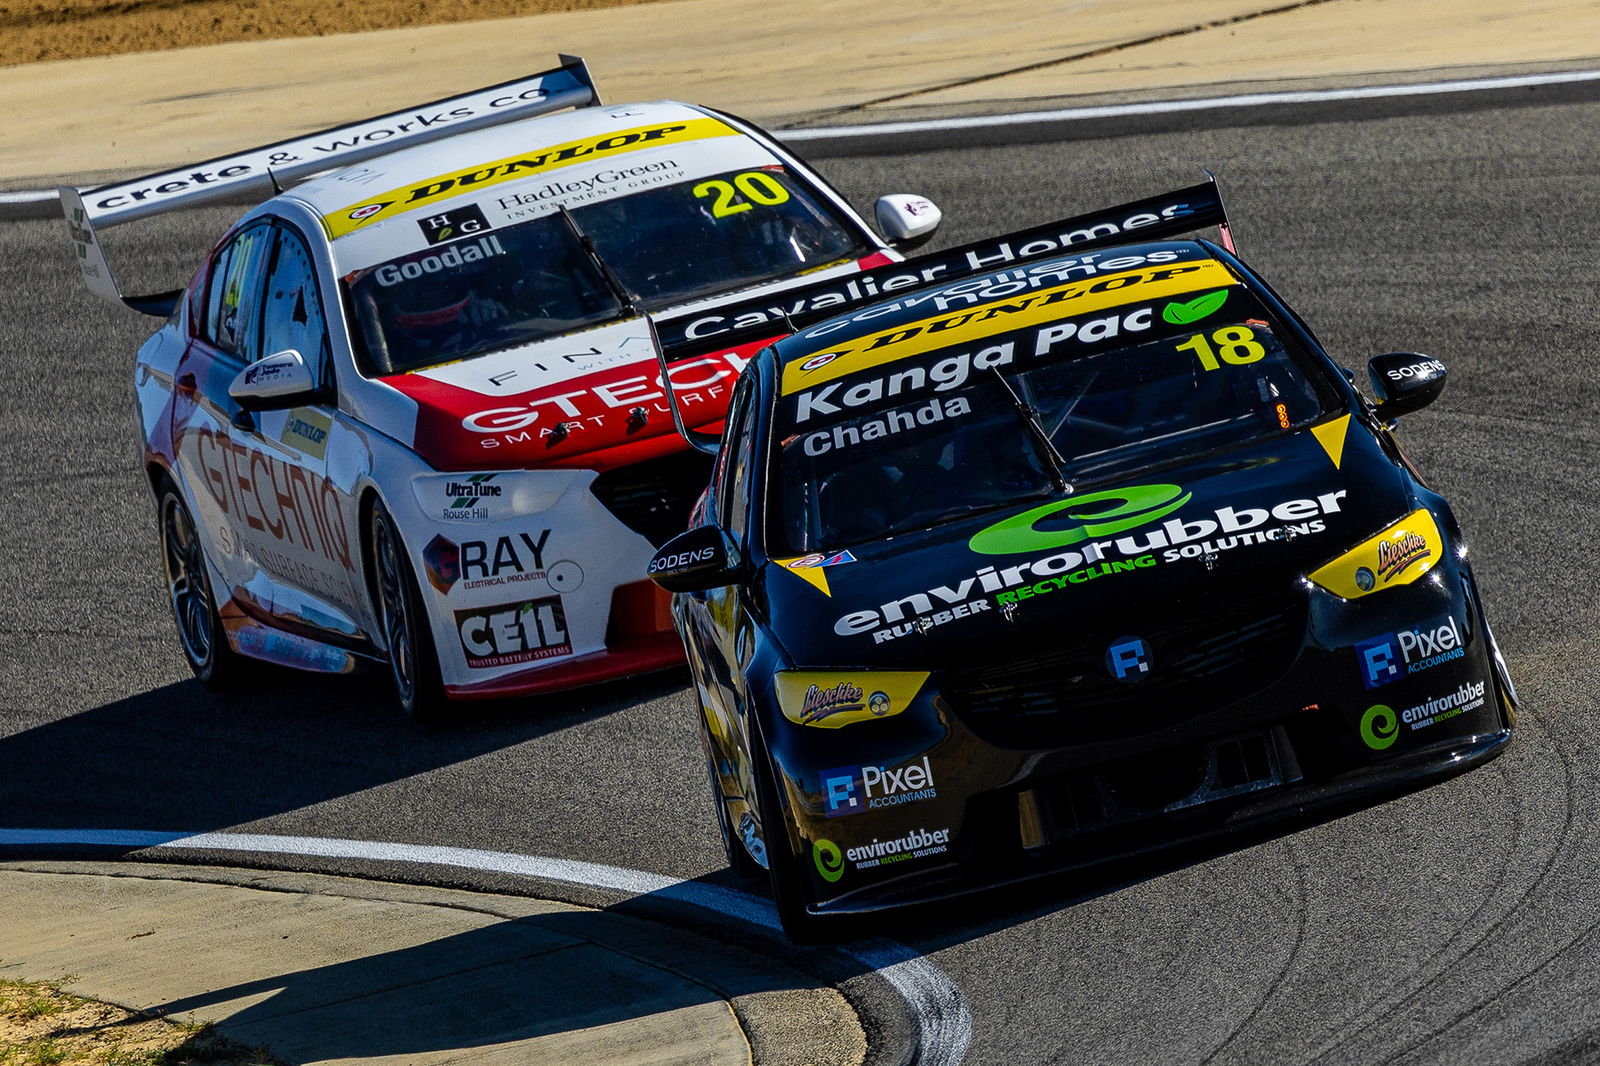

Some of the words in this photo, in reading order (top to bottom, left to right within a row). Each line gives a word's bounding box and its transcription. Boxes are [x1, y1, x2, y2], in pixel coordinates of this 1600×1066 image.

[96, 165, 251, 208] crete
[269, 152, 302, 166] &
[313, 107, 474, 153] works
[404, 125, 686, 204] DUNLOP
[498, 158, 680, 210] HadleyGreen
[506, 186, 620, 219] INVESTMENT
[628, 170, 686, 189] GROUP
[692, 172, 790, 218] 20
[375, 234, 504, 288] Goodall
[684, 264, 947, 340] Cavalier
[966, 203, 1195, 270] Homes
[863, 265, 1201, 352] DUNLOP
[796, 340, 1015, 423] Kanga
[1035, 307, 1152, 357] Pac
[1175, 326, 1266, 371] 18
[1387, 359, 1446, 380] SODENS
[292, 419, 327, 444] DUNLOP
[480, 414, 605, 449] SMART
[803, 396, 971, 457] Chahda
[443, 508, 470, 520] Rouse
[472, 507, 489, 519] Hill
[464, 577, 506, 590] ELECTRICAL
[507, 571, 547, 583] PROJECTS
[650, 547, 715, 573] SODENS
[834, 489, 1347, 636] envirorubber
[995, 555, 1157, 606] RECYCLING
[468, 658, 499, 668] TRUSTED
[500, 653, 533, 665] BATTERY
[534, 645, 571, 659] SYSTEMS
[1397, 615, 1462, 664] Pixel
[1407, 647, 1465, 674] ACCOUNTANTS
[1402, 681, 1485, 724] envirorubber
[862, 756, 934, 798] Pixel
[869, 788, 937, 808] ACCOUNTANTS
[847, 828, 950, 861] envirorubber
[856, 859, 880, 870] RUBBER
[880, 853, 913, 865] RECYCLING
[913, 845, 948, 858] SOLUTIONS
